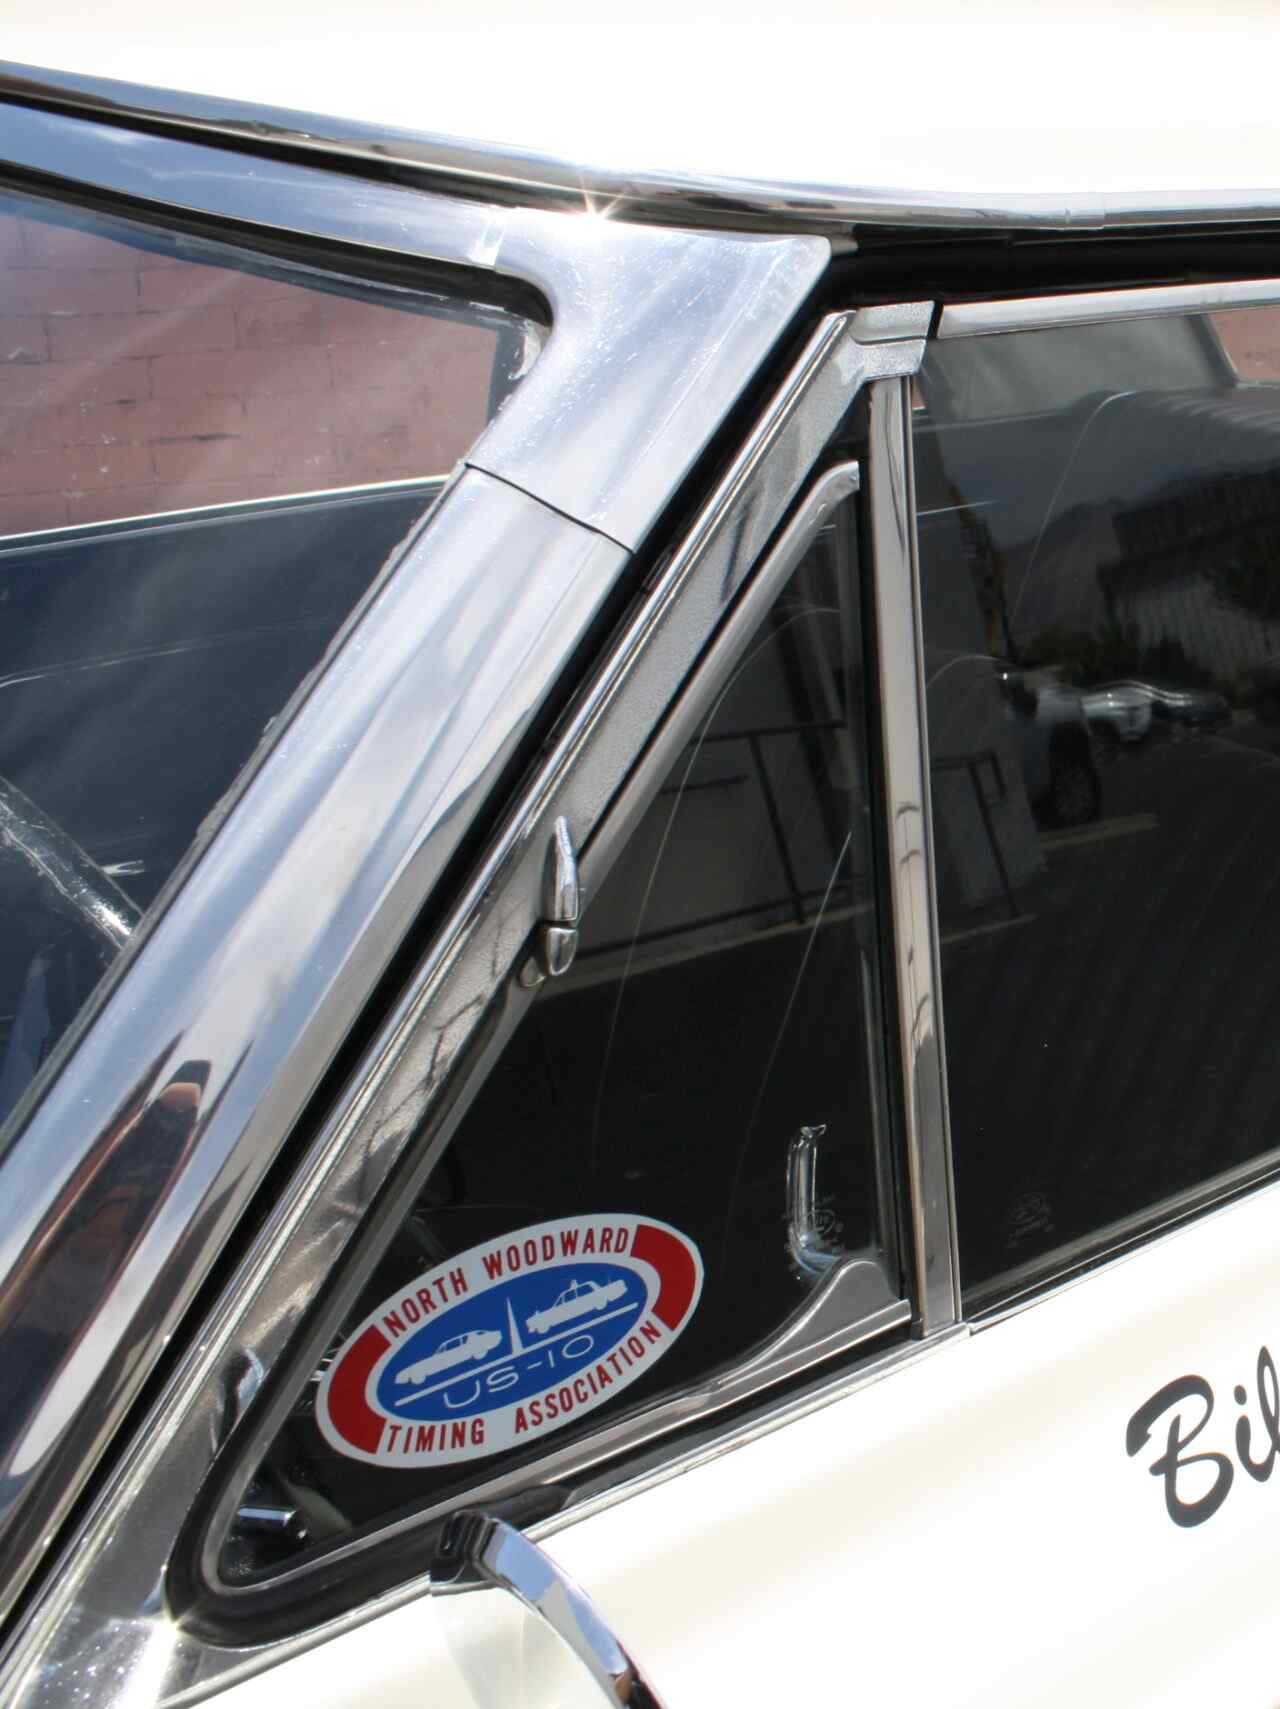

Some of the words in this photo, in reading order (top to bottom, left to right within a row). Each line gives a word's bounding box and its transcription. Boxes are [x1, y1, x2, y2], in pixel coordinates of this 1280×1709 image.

[382, 1268, 469, 1338] NORTH
[482, 1227, 630, 1281] WOODWARD
[387, 1418, 486, 1455] TIMING
[514, 1320, 662, 1434] ASSOCIATION
[443, 1334, 595, 1409] US-10
